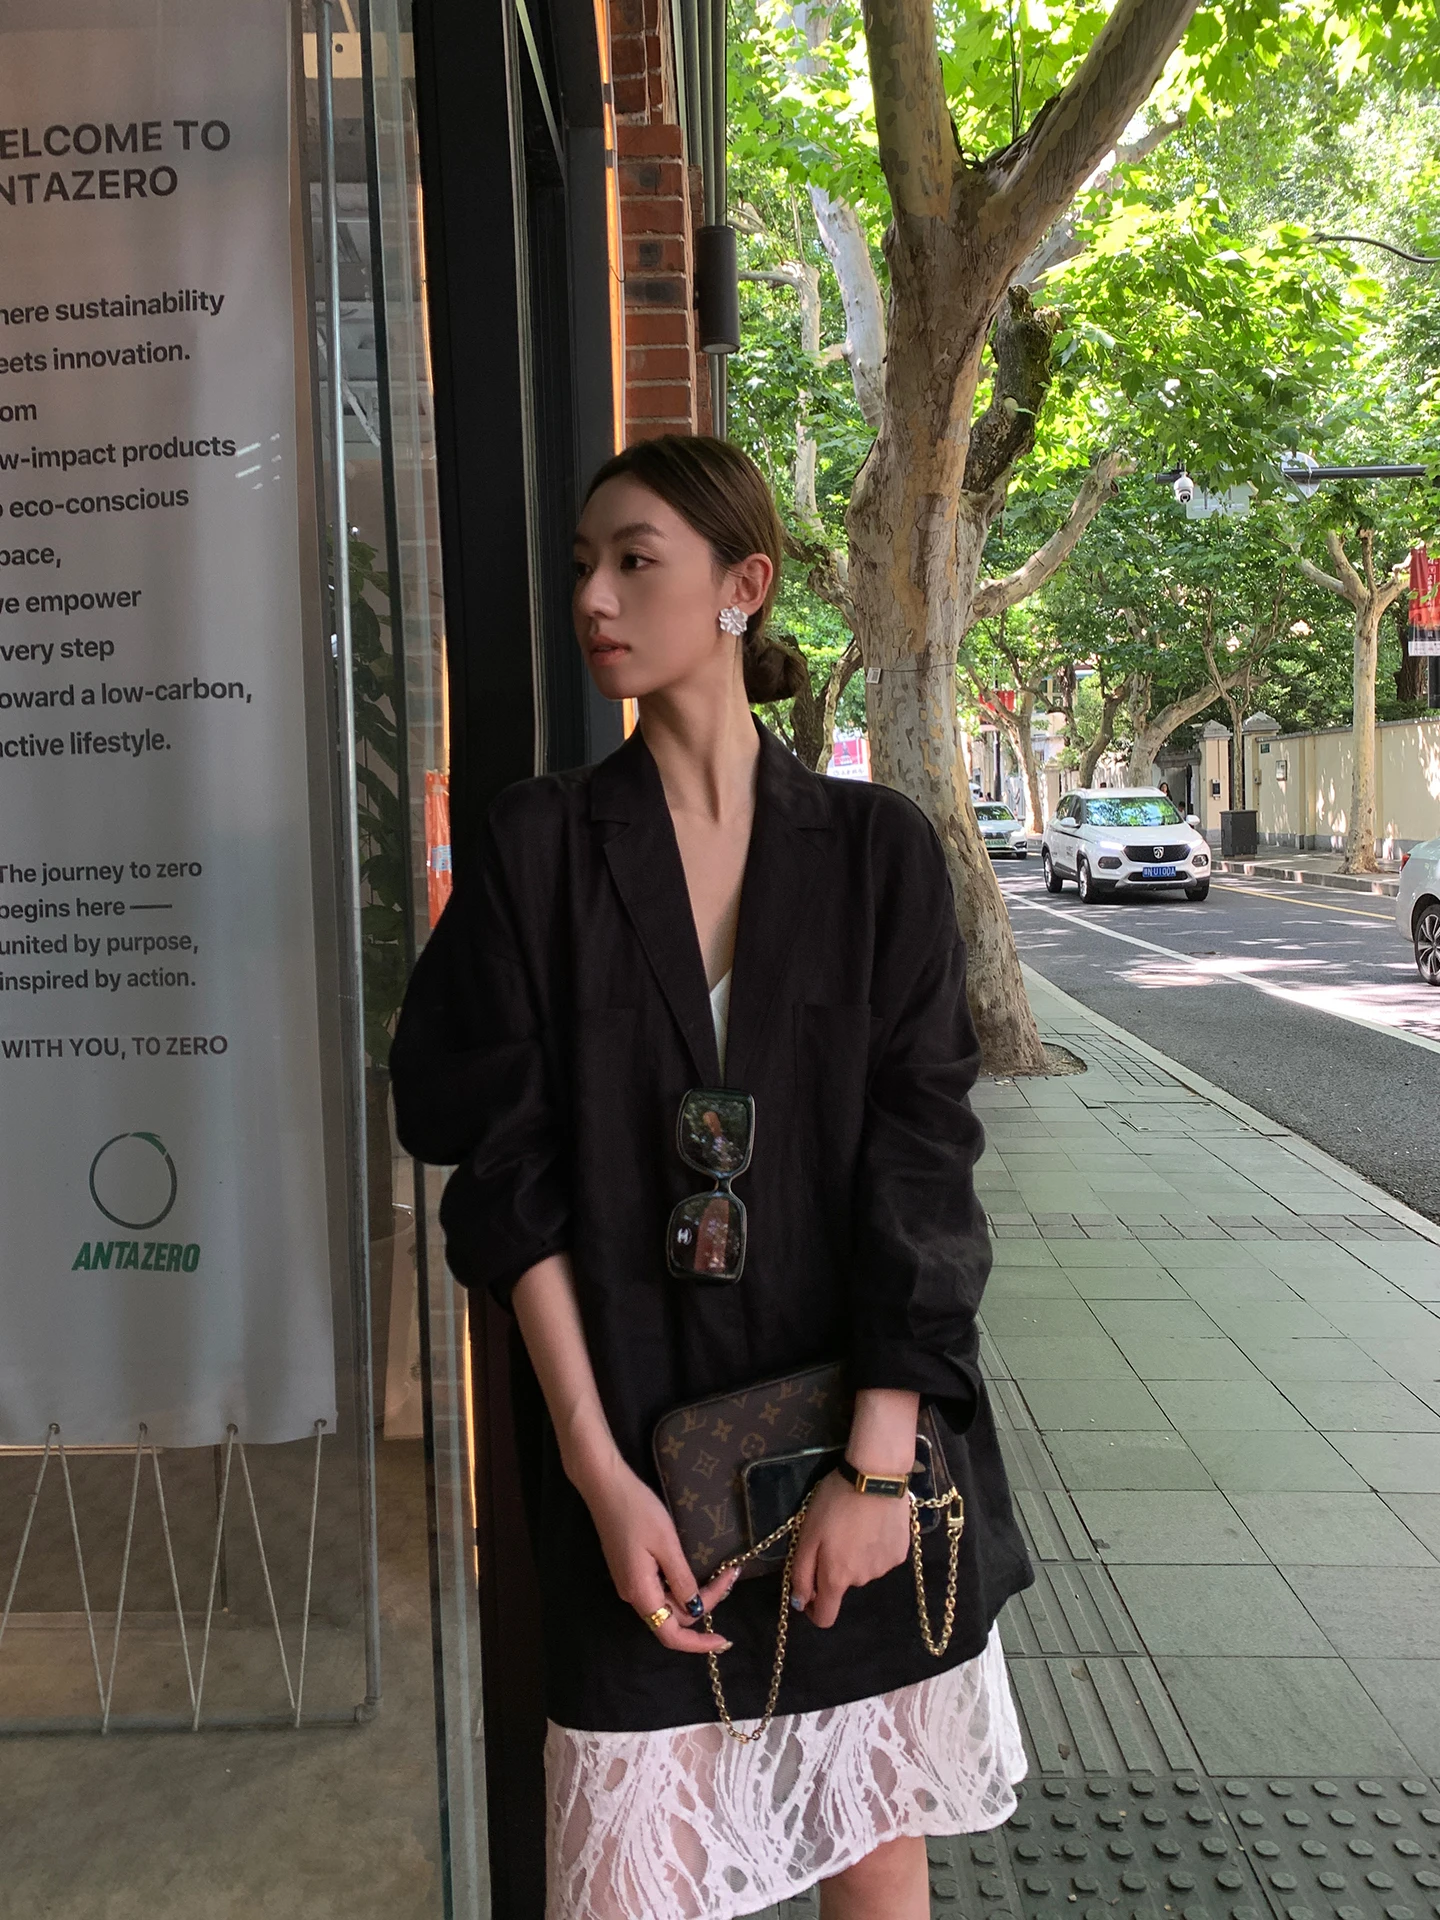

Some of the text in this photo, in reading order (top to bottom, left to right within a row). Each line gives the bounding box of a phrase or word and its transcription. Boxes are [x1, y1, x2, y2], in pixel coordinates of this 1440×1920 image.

[173, 120, 230, 152] TO
[55, 289, 225, 321] sustainability
[53, 341, 190, 370] innovation.
[122, 436, 237, 467] products
[9, 487, 189, 518] eco-conscious
[0, 590, 142, 616] e empower
[60, 638, 115, 662] step
[81, 689, 95, 705] a
[101, 677, 252, 704] low-carbon,
[0, 728, 171, 758] ctive lifestyle.
[41, 862, 124, 887] journey
[129, 861, 151, 879] to
[156, 862, 202, 878] zero
[76, 897, 125, 917] here
[0, 933, 198, 957] united by purpose,
[0, 967, 196, 995] inspired by action.
[1, 1035, 228, 1060] WITH YOU, TO ZERO
[71, 1241, 200, 1273] ANTAZERO
